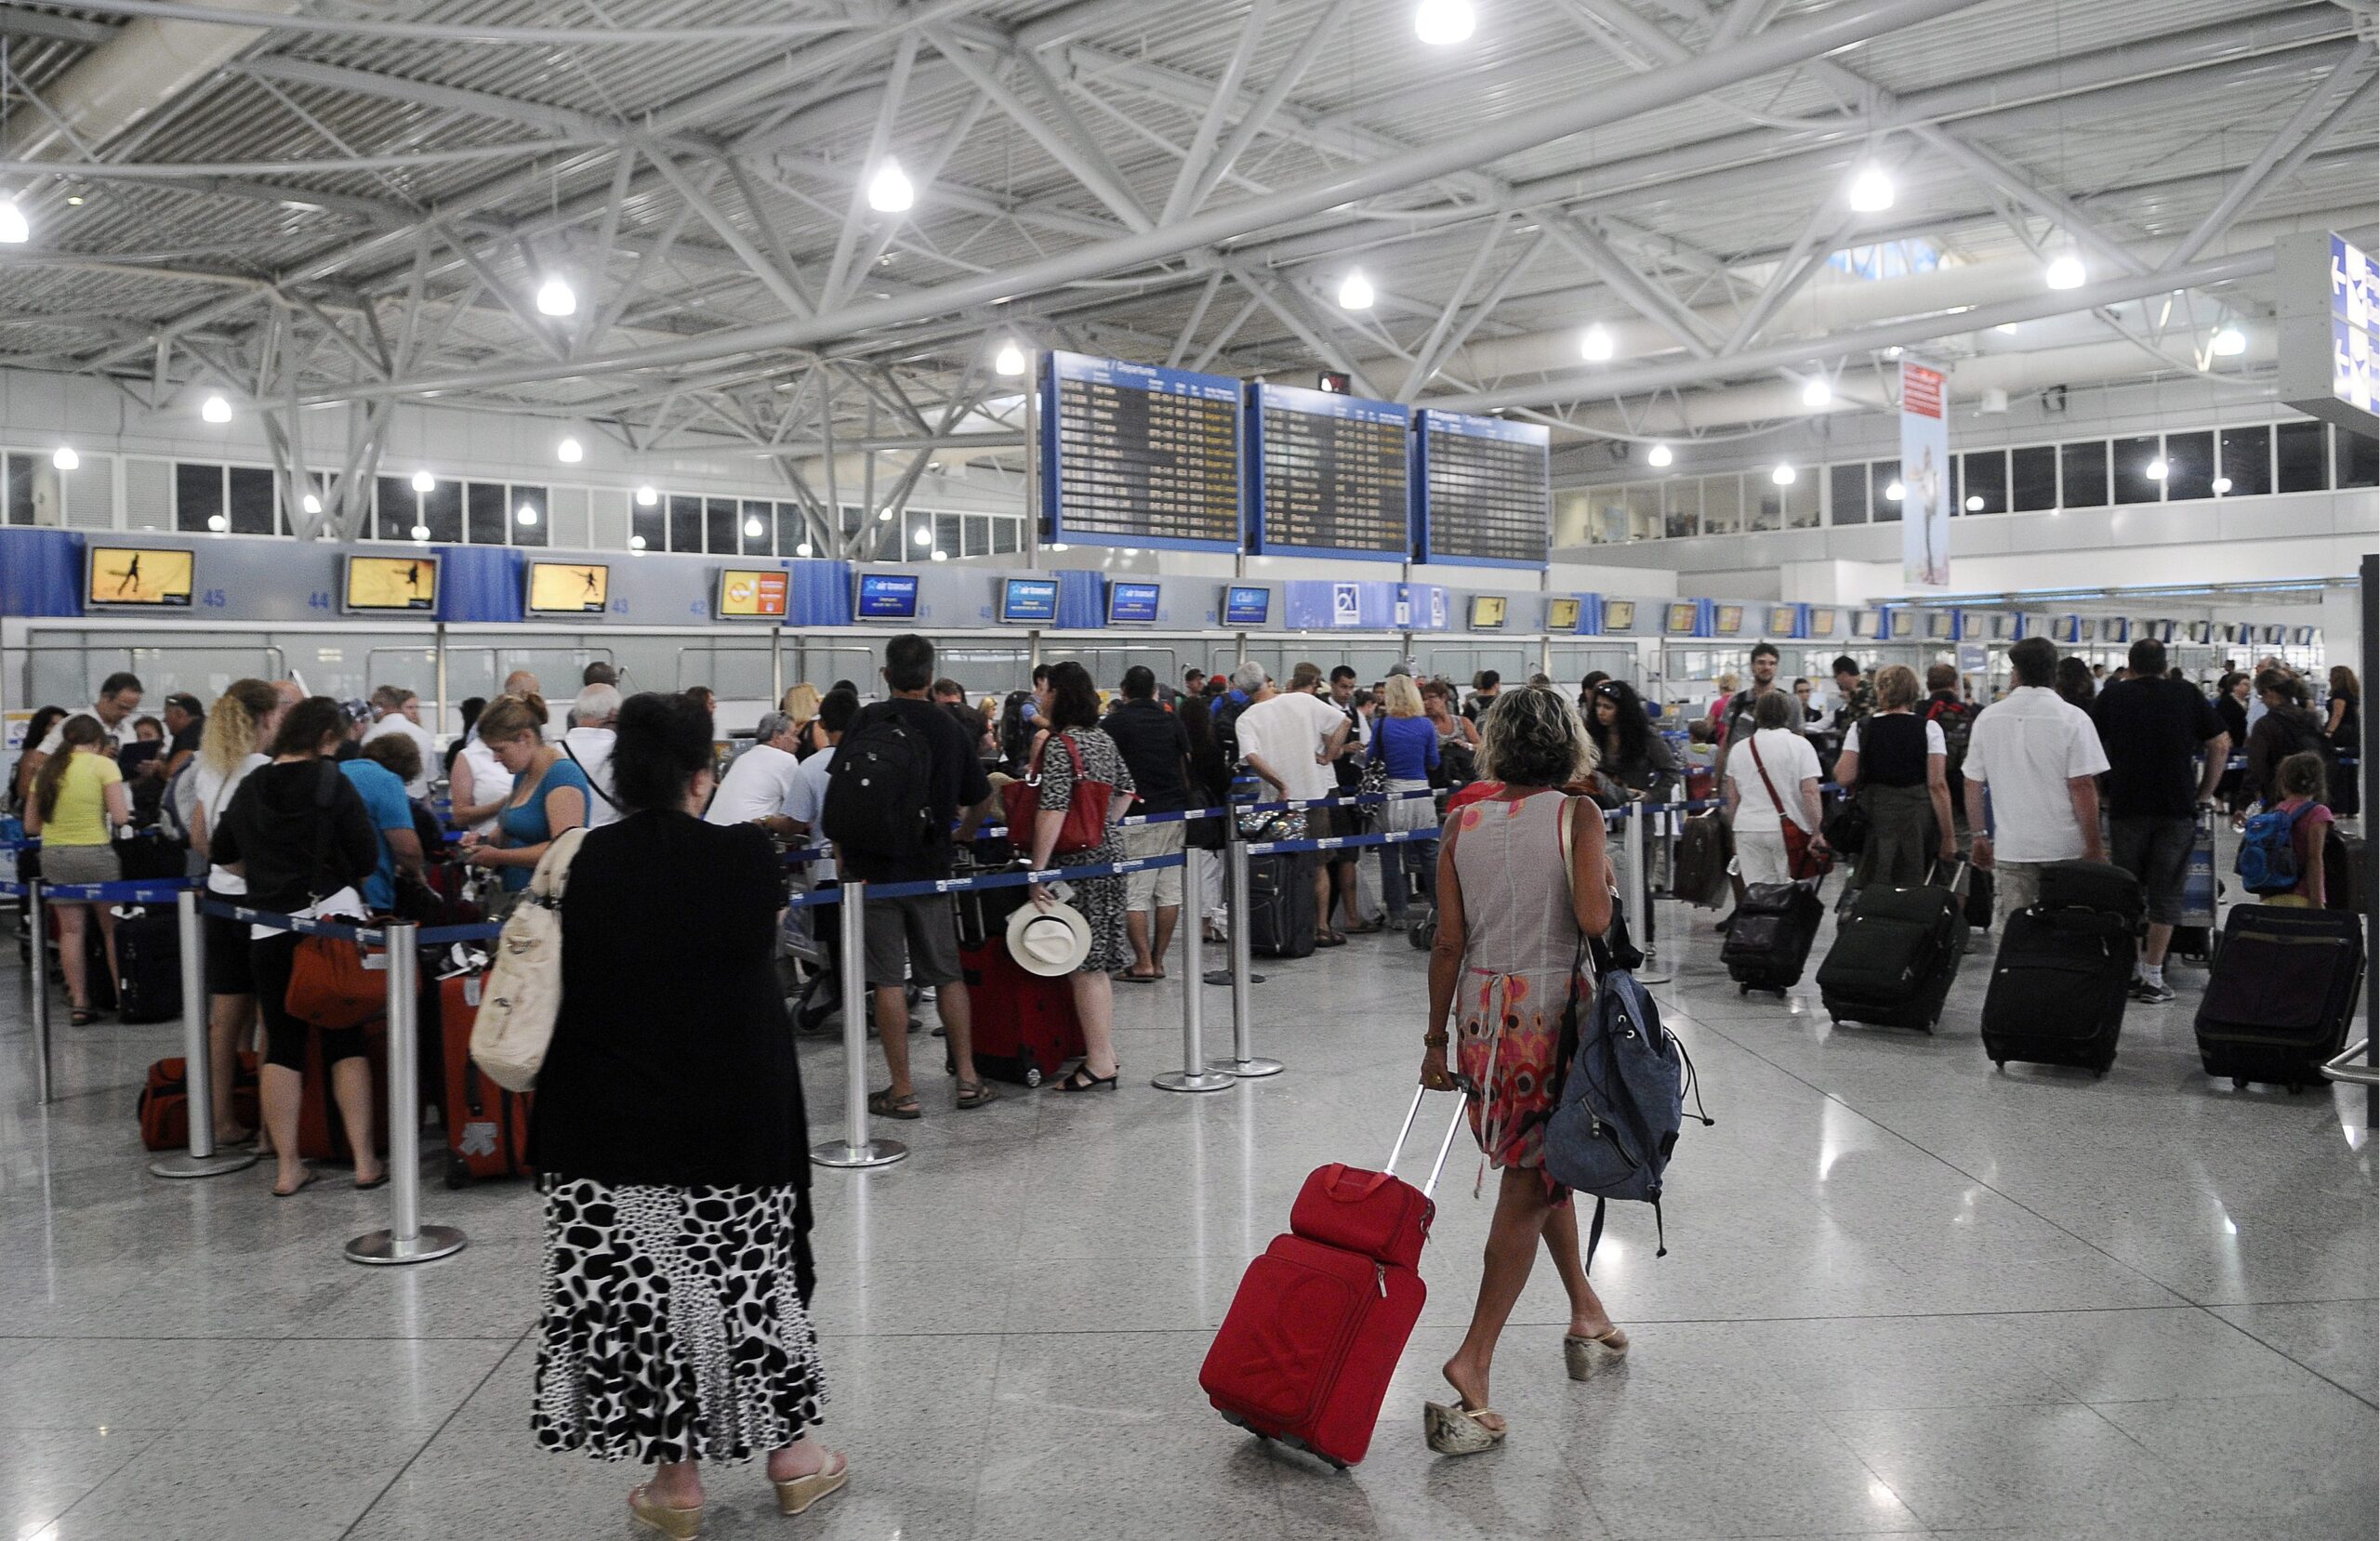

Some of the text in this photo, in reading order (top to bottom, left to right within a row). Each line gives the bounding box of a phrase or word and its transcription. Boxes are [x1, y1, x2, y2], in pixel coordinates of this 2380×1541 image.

[204, 588, 226, 607] 45
[308, 592, 329, 609] 44
[613, 598, 628, 614] 43
